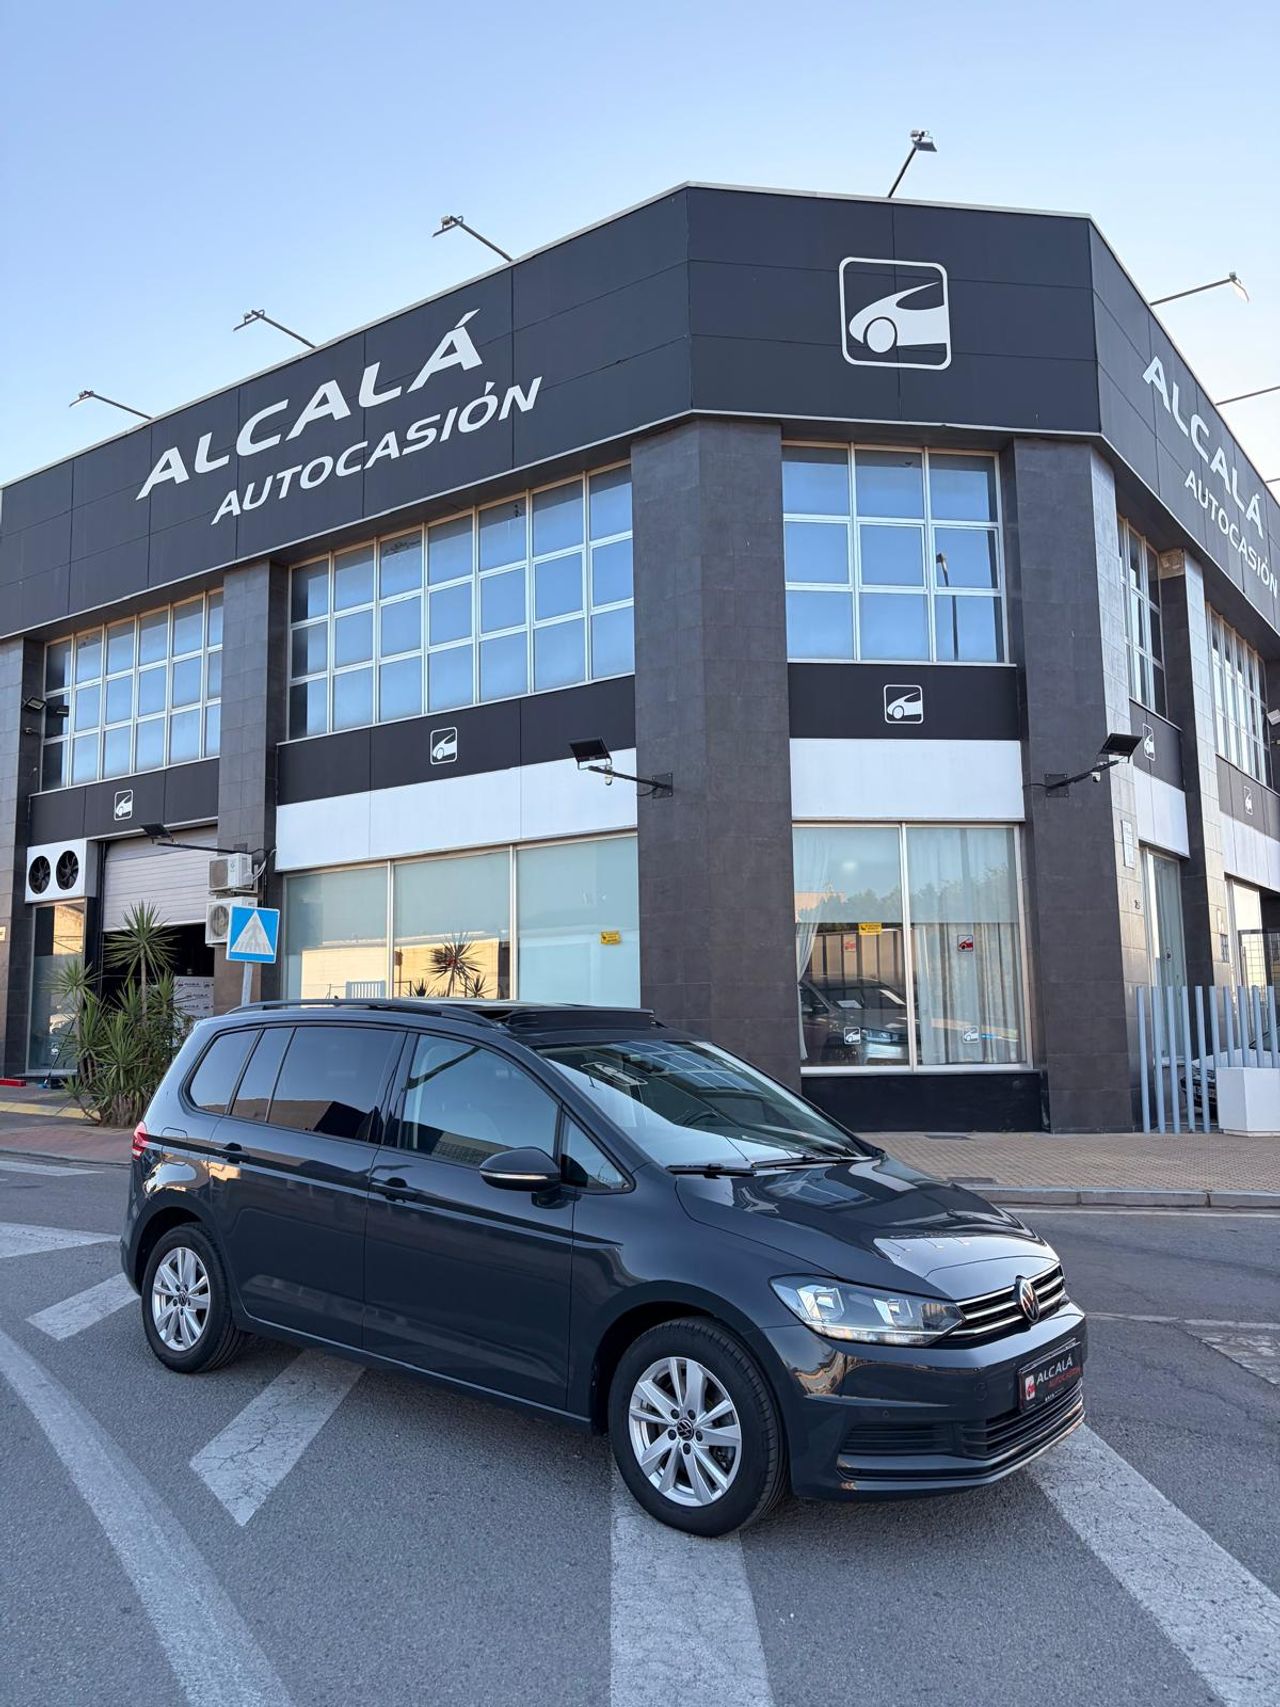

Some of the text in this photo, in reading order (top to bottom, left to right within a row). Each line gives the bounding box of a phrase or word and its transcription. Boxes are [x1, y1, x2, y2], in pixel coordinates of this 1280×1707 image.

[135, 308, 483, 501] ALCALÁ
[210, 376, 543, 526] AUTOCASIÓN
[1142, 356, 1264, 539] ALCALÁ
[1184, 469, 1278, 599] AUTOCASIÓN
[1036, 1353, 1073, 1385] ALCALÁ
